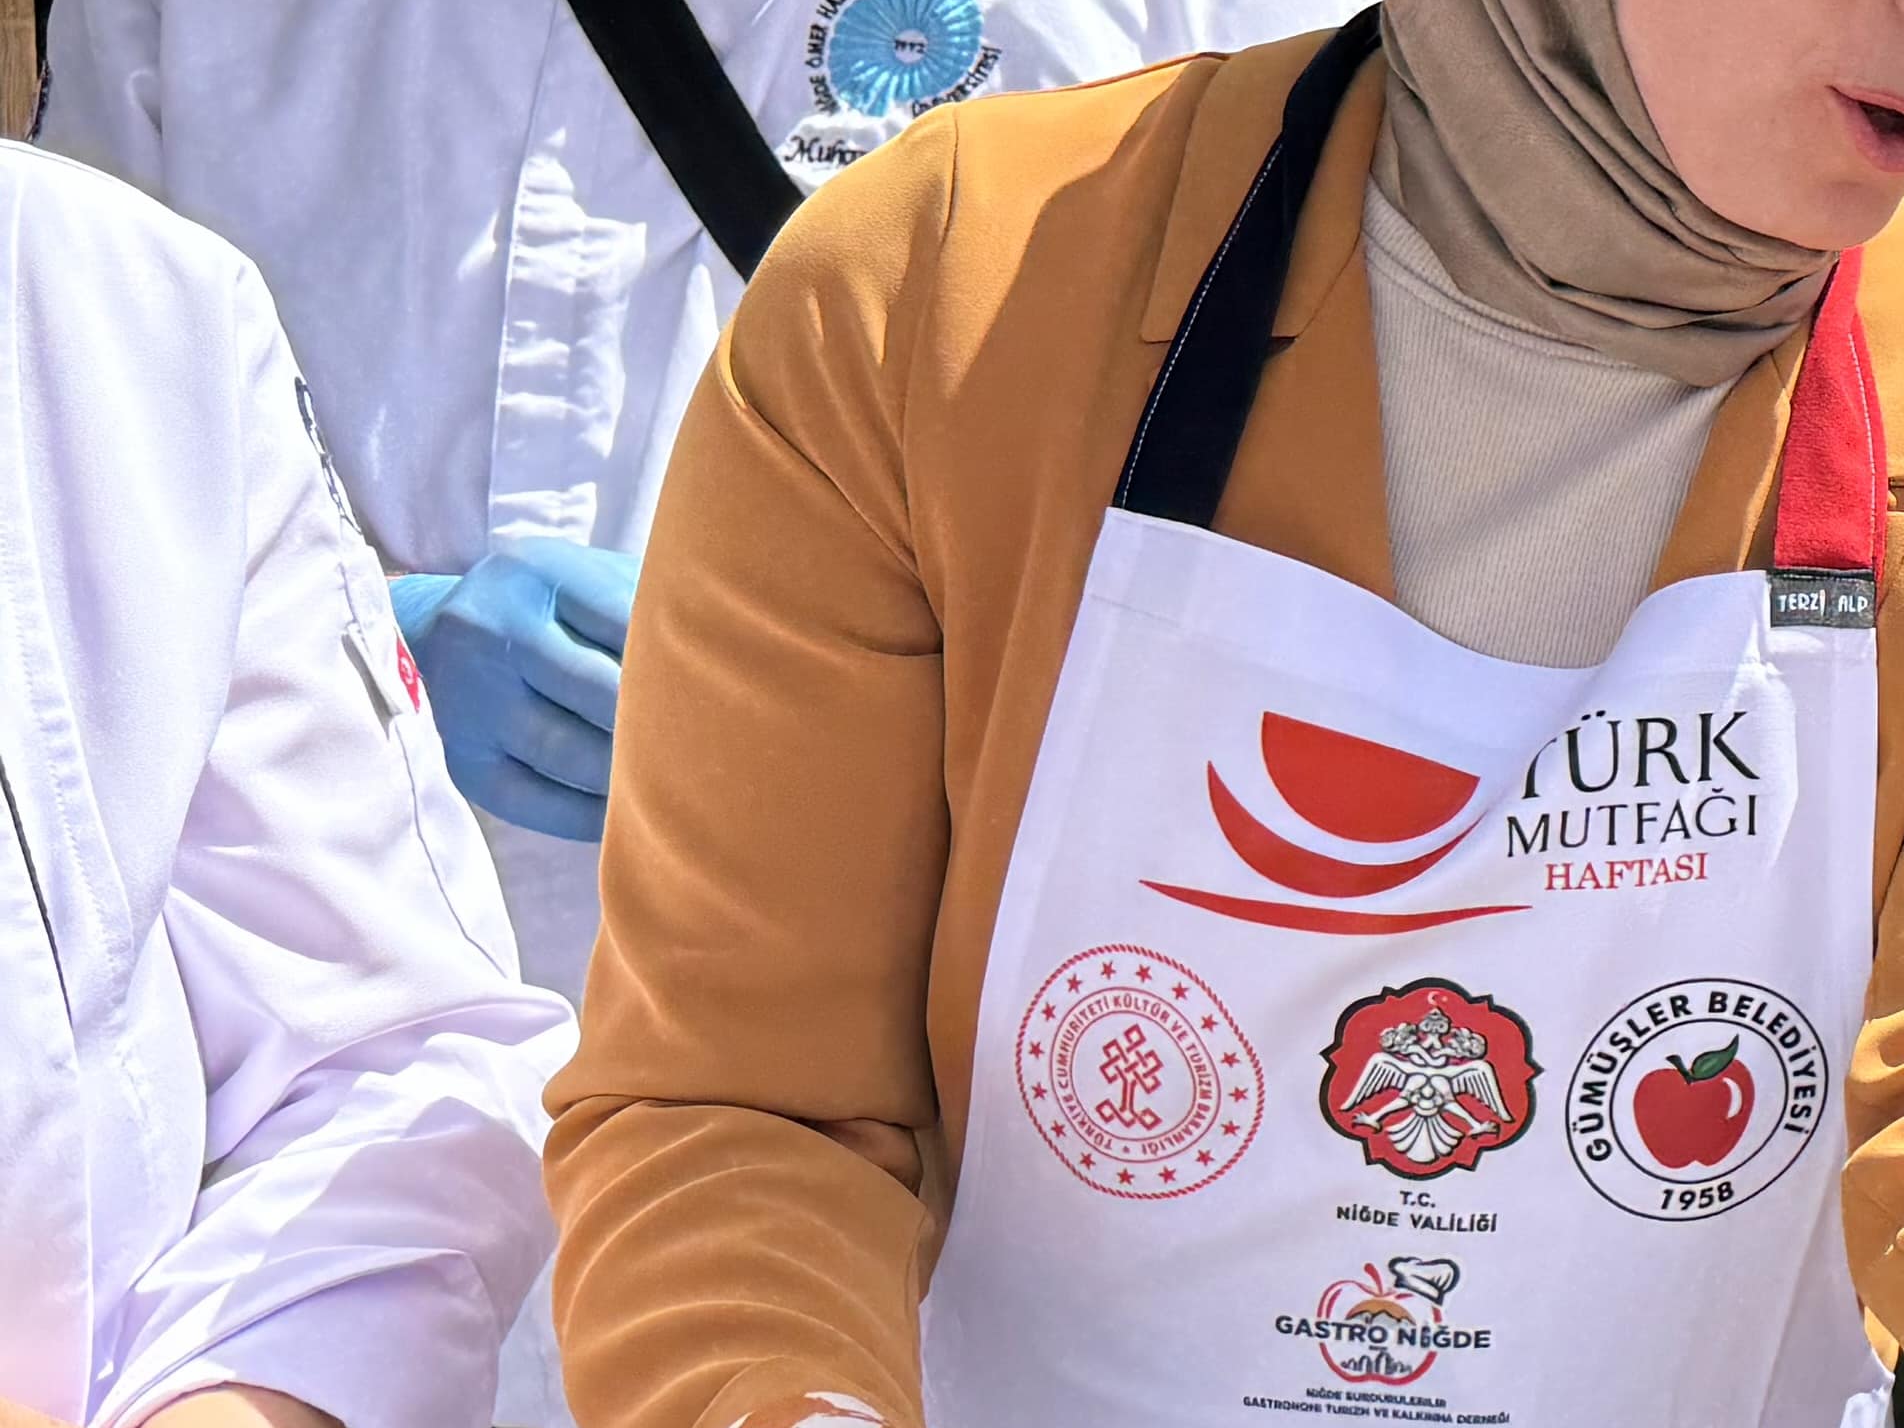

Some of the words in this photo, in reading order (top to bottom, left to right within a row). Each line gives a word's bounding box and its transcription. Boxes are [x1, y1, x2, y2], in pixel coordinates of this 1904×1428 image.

[1837, 595, 1869, 613] ALP
[1521, 710, 1761, 800] TÜRK
[1506, 787, 1758, 858] MUTFAĞI
[1544, 852, 1709, 891] HAFTASI
[1055, 996, 1111, 1091] CUMHURİYETİ
[1113, 992, 1171, 1025] KÜLTÜR
[1171, 1021, 1189, 1043] VE
[1572, 994, 1694, 1162] GÜMÜŞLER
[1707, 990, 1818, 1135] BELEDİYESİ
[1400, 1190, 1437, 1208] T.C.
[1660, 1180, 1736, 1211] 1958
[1336, 1204, 1400, 1227] NİĞDE
[1410, 1213, 1498, 1233] VALİLİĞİ
[1275, 1315, 1388, 1345] GASTRO
